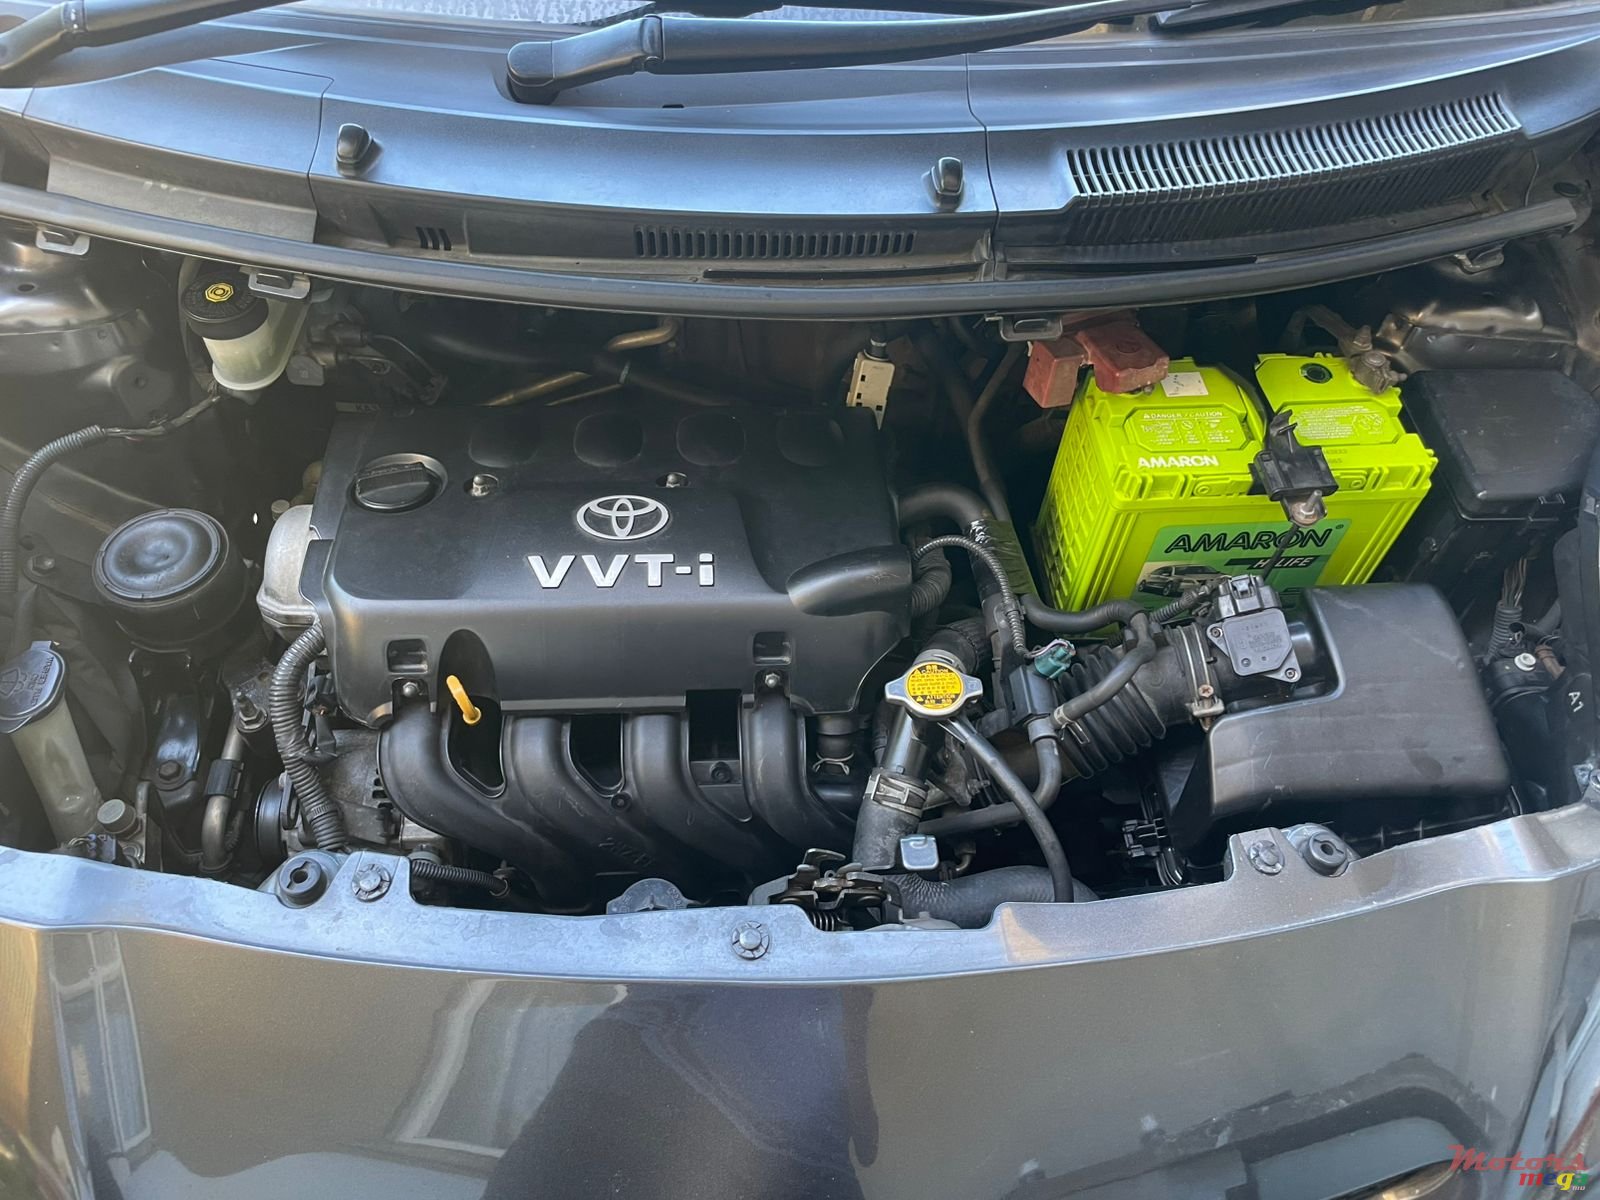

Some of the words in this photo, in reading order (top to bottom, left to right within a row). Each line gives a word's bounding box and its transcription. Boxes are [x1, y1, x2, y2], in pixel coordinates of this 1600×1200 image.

[1138, 455, 1219, 468] AMARON
[1164, 528, 1333, 554] AMARON
[527, 553, 715, 588] VVT-i
